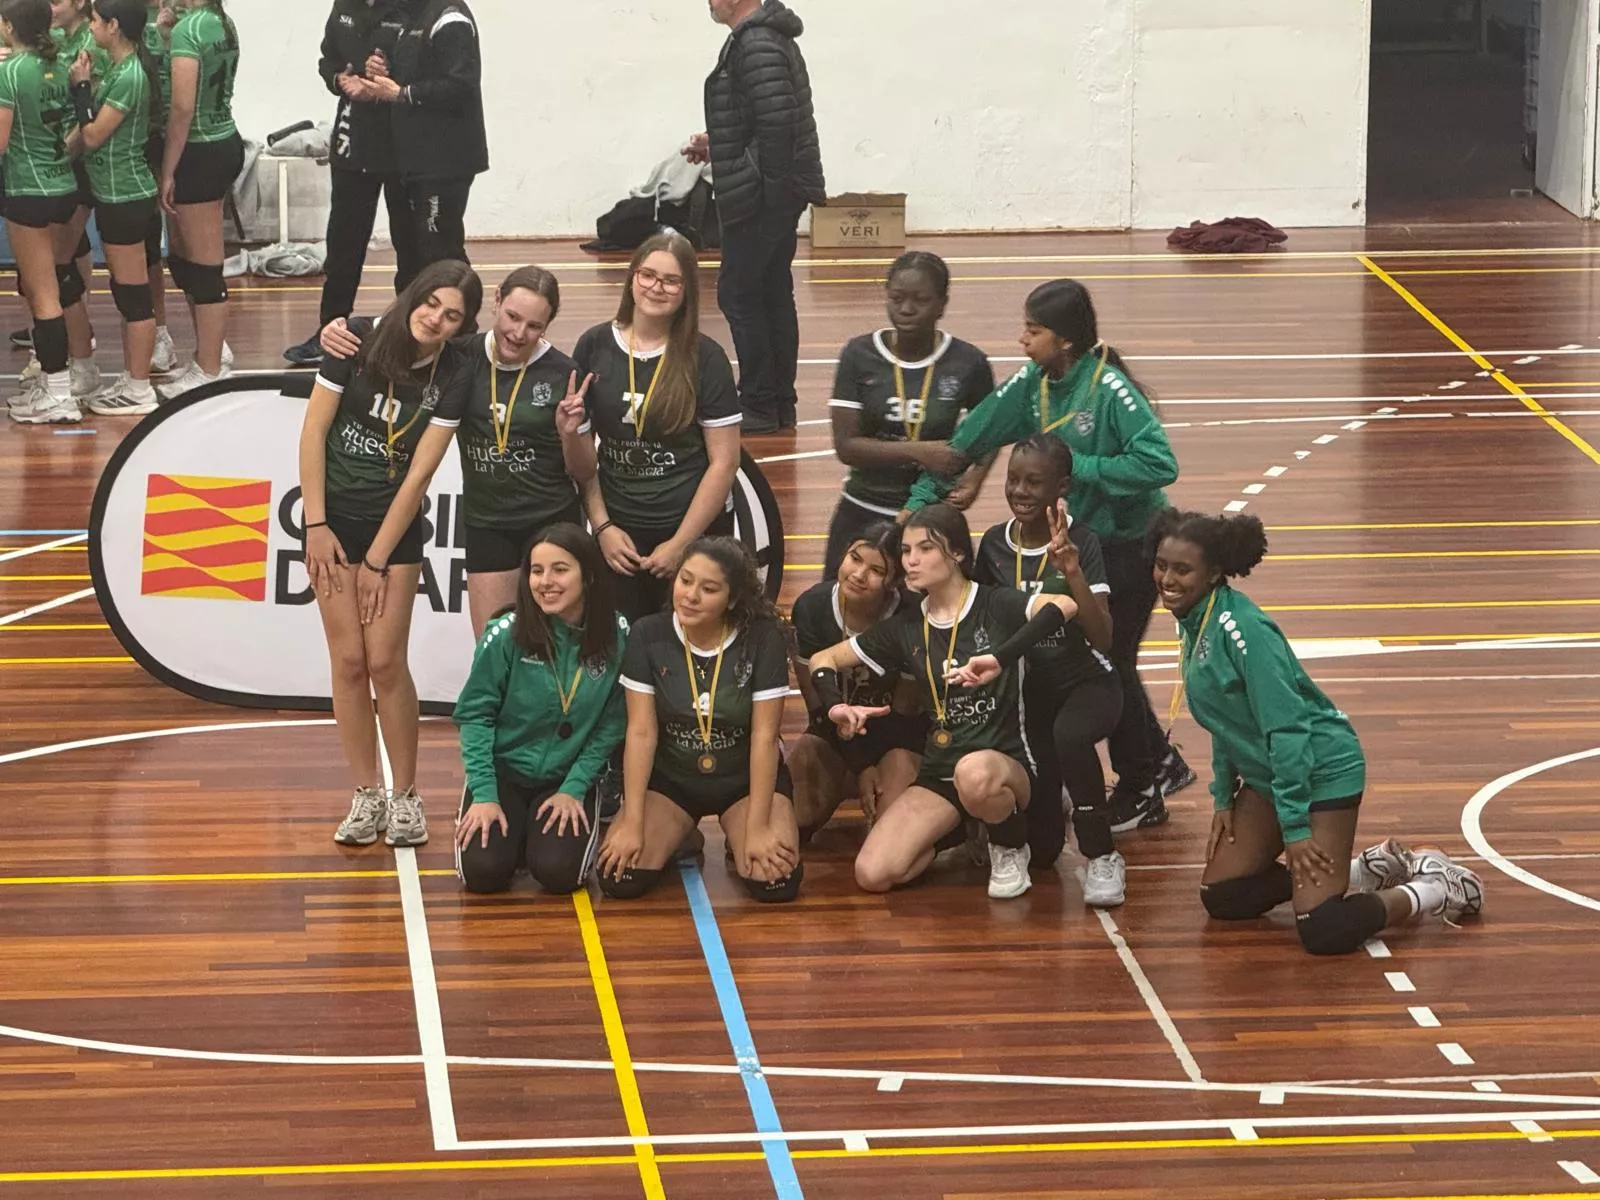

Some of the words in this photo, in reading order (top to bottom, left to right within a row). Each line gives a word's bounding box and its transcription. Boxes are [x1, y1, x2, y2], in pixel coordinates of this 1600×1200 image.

[839, 226, 880, 237] VERI
[369, 393, 402, 423] 10
[622, 392, 645, 424] 7
[884, 396, 926, 424] 36
